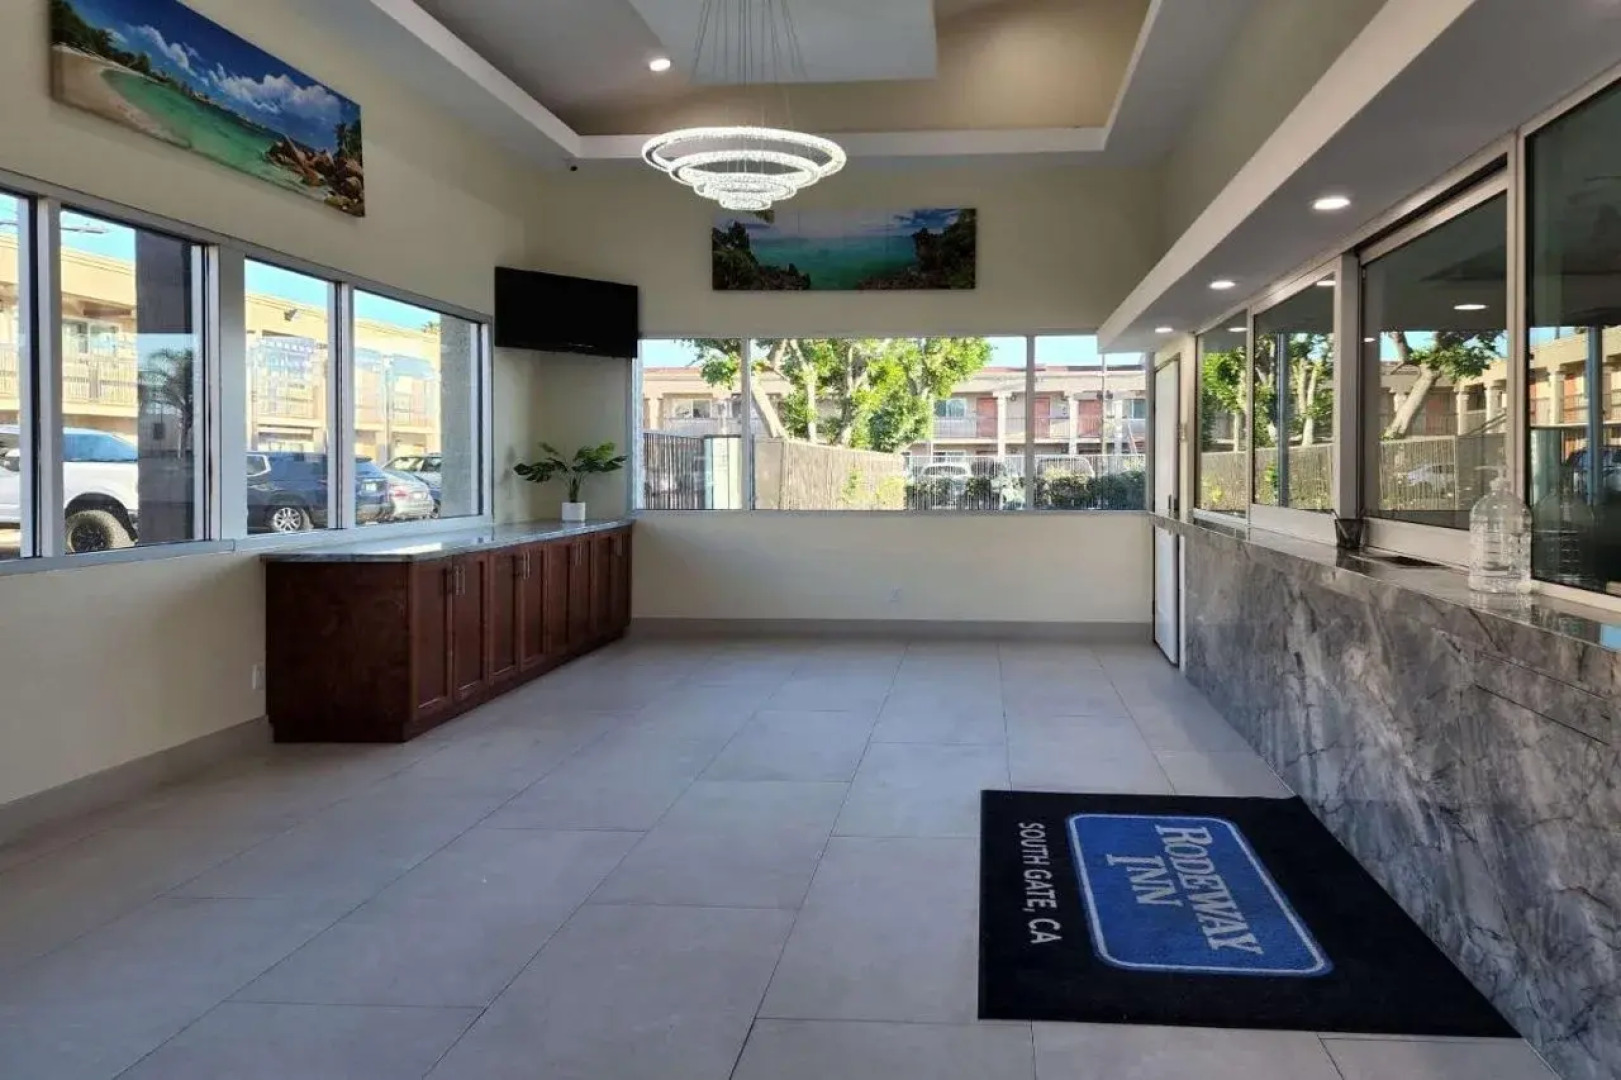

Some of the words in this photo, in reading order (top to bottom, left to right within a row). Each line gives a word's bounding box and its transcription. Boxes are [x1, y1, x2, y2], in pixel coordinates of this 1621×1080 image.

[1018, 821, 1050, 867] SOUTH
[1023, 869, 1057, 912] GATE,
[1106, 853, 1184, 907] INN
[1154, 824, 1264, 955] RODEWAY
[1028, 918, 1062, 944] CA
